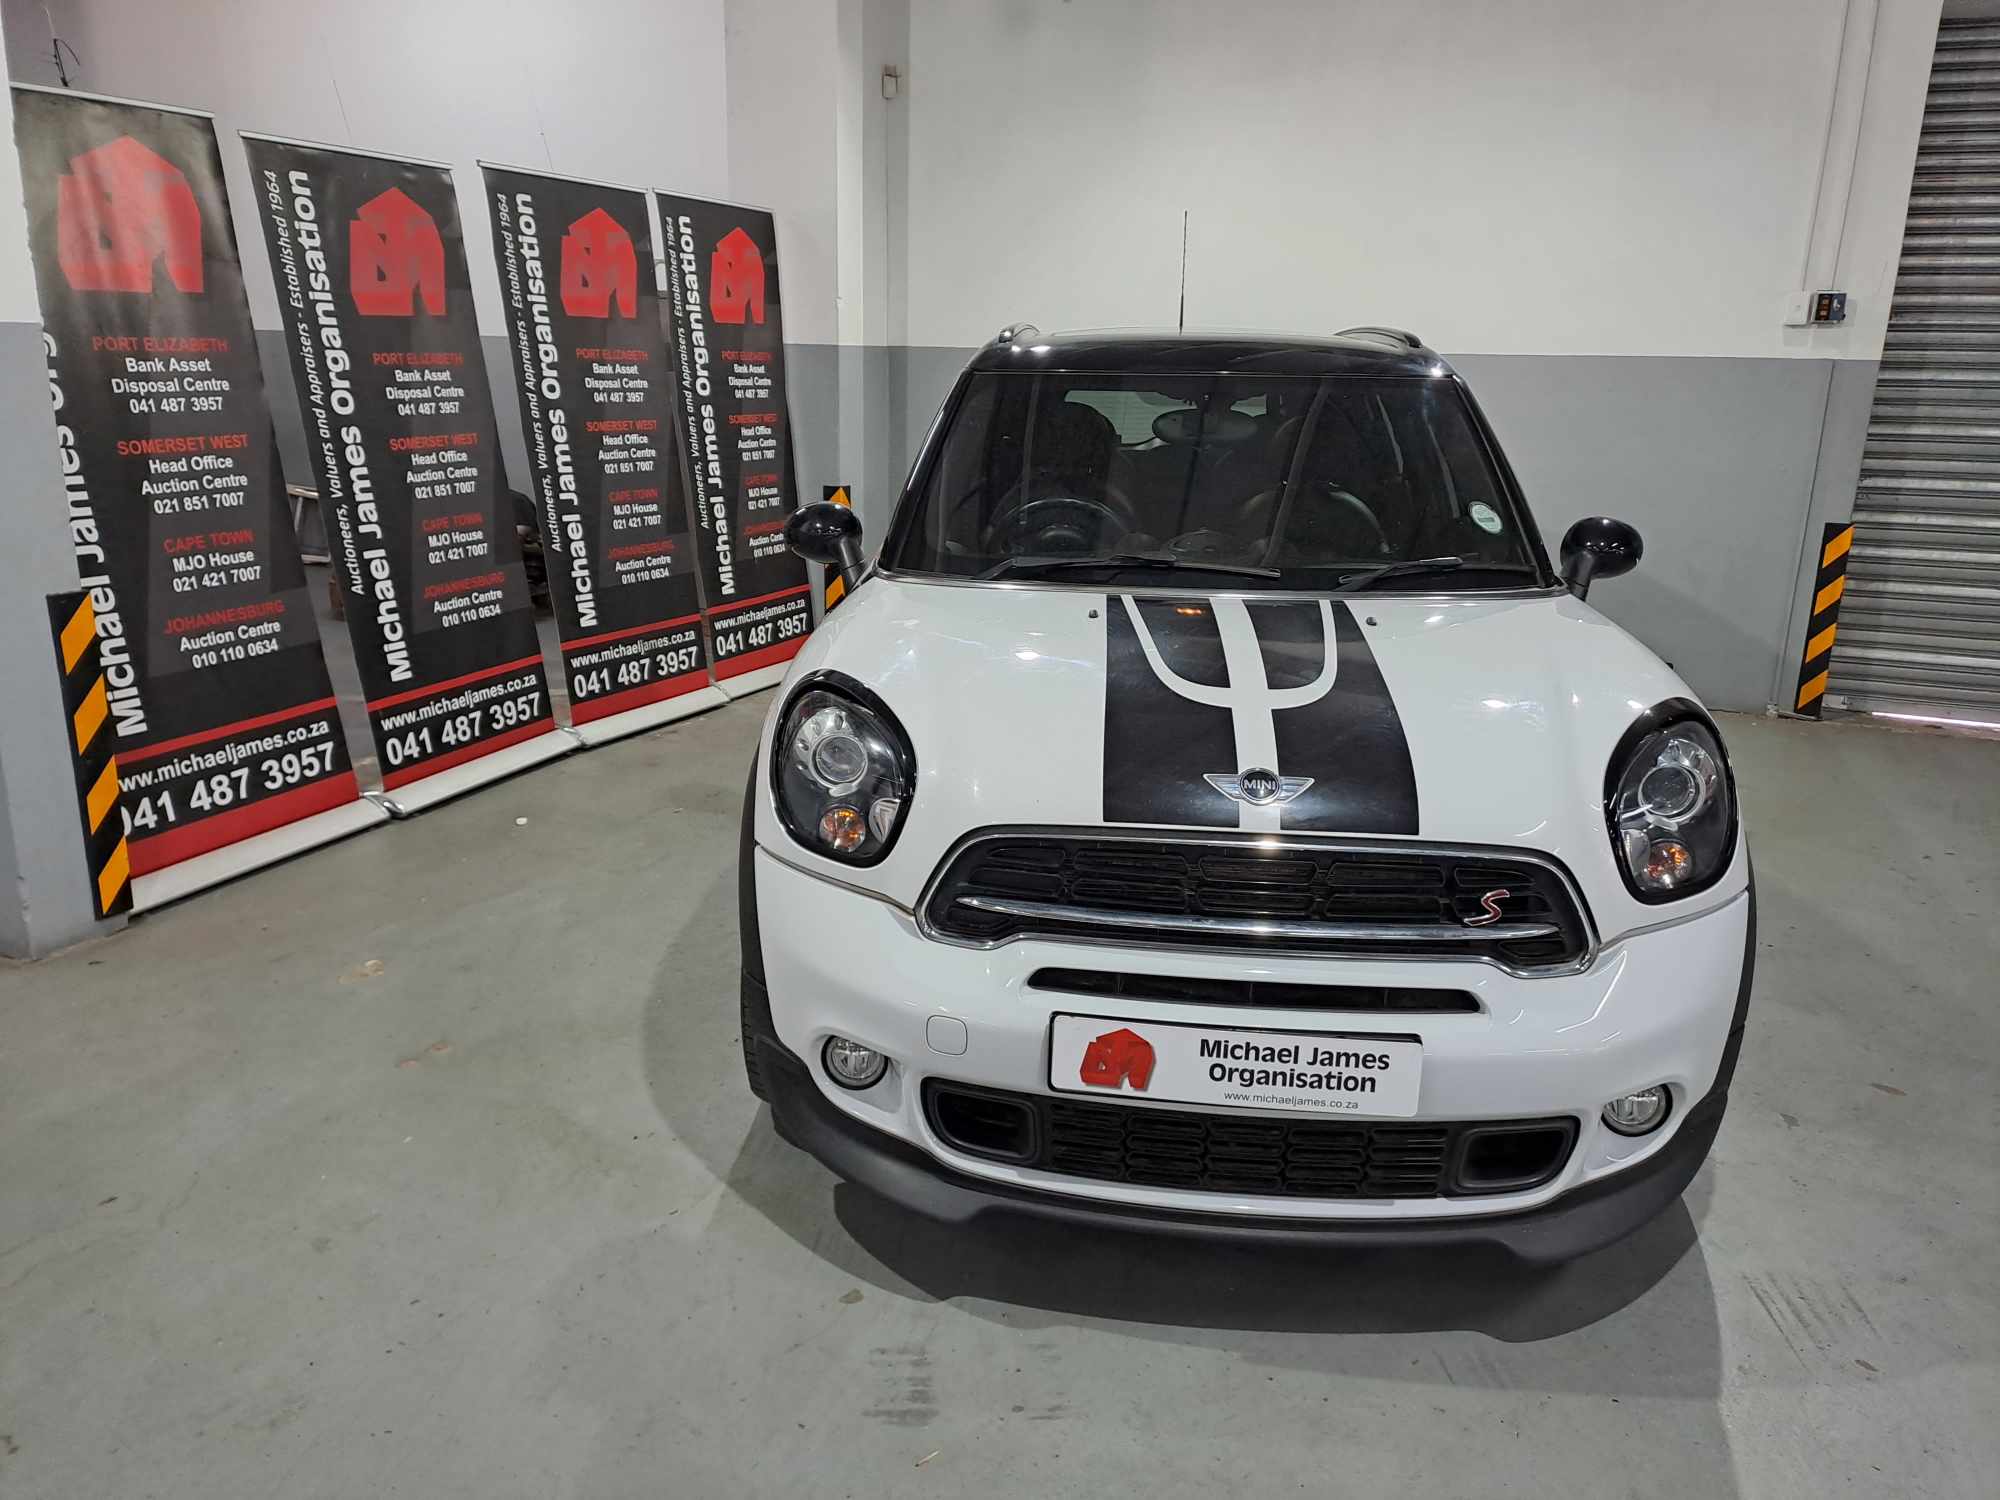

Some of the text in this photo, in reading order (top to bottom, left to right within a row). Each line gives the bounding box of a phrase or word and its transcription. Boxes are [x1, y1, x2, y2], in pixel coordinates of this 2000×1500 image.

[497, 193, 512, 229] 1964
[665, 216, 678, 246] 1964
[501, 231, 524, 309] Established
[91, 336, 229, 352] PORT ELIZABETH
[516, 319, 536, 391] Appraisers
[125, 357, 212, 373] Bank Asset
[372, 352, 404, 365] PORT
[592, 363, 639, 375] Bank Asset
[111, 377, 230, 395] Disposal Centre
[263, 169, 365, 595] Auctioneers, Valuers and Appraisers Established 1964
[395, 369, 451, 382] Bank Asset
[585, 377, 648, 390] Disposal Centre
[130, 396, 223, 414] 041 487 3957
[386, 386, 464, 401] Disposal Centre
[526, 391, 540, 419] and
[593, 392, 644, 402] 041 487 3957
[683, 388, 694, 415] and
[398, 401, 459, 416] 041 487 3957
[515, 193, 598, 628] Michael James Organisation
[678, 215, 736, 596] Michael James Organisation
[288, 170, 413, 683] Michael James Organisation
[687, 415, 700, 457] Valuers
[117, 434, 248, 456] SOMERSET WEST
[389, 435, 448, 450] SOMERSET
[531, 421, 548, 470] Valuers
[602, 434, 648, 445] Head Office
[149, 455, 233, 474] Head Office
[411, 451, 467, 465] Head Office
[598, 448, 656, 460] Auction Centre
[406, 466, 478, 483] Auction Centre
[604, 463, 618, 474] 021
[141, 474, 248, 495] Auction Centre
[415, 481, 475, 499] 021 851 7007
[154, 491, 244, 514] 021 851 7007
[613, 503, 658, 515] MJO House
[613, 518, 626, 530] 021
[628, 516, 642, 527] 421
[163, 529, 254, 553] CAPE TOWN
[428, 530, 483, 547] MJO House
[172, 551, 254, 573] MJO House
[429, 543, 488, 564] 021 421 7007
[615, 555, 671, 572] Auction Centre
[173, 565, 261, 592] 021 421 7007
[621, 573, 635, 584] 010
[636, 570, 650, 581] 110
[434, 589, 503, 613] Auction Centre
[164, 600, 286, 635] JOHANNESBURG
[442, 603, 501, 628] 010 110 0634
[714, 598, 806, 630] www.michaeljames.co.za
[180, 621, 281, 652] Auction Centre
[716, 613, 808, 656] 041 487 3957
[81, 574, 147, 737] Michael
[192, 638, 278, 669] 010 110 0634
[570, 629, 696, 668] www.michaeljames.co.za
[574, 646, 699, 698] 041 487 3957
[381, 674, 537, 731] www.michaeljames.co.za
[386, 692, 540, 766] 041 487 3957
[118, 719, 329, 792] ww.michaeljames.co.za
[190, 767, 249, 811] 487
[261, 741, 334, 790] 3957
[1243, 779, 1276, 790] MINI
[1464, 889, 1510, 926] S
[1199, 1038, 1390, 1071] Michael James
[1208, 1062, 1377, 1093] Organisation
[1224, 1090, 1359, 1110] www.michaeljames.co.za
